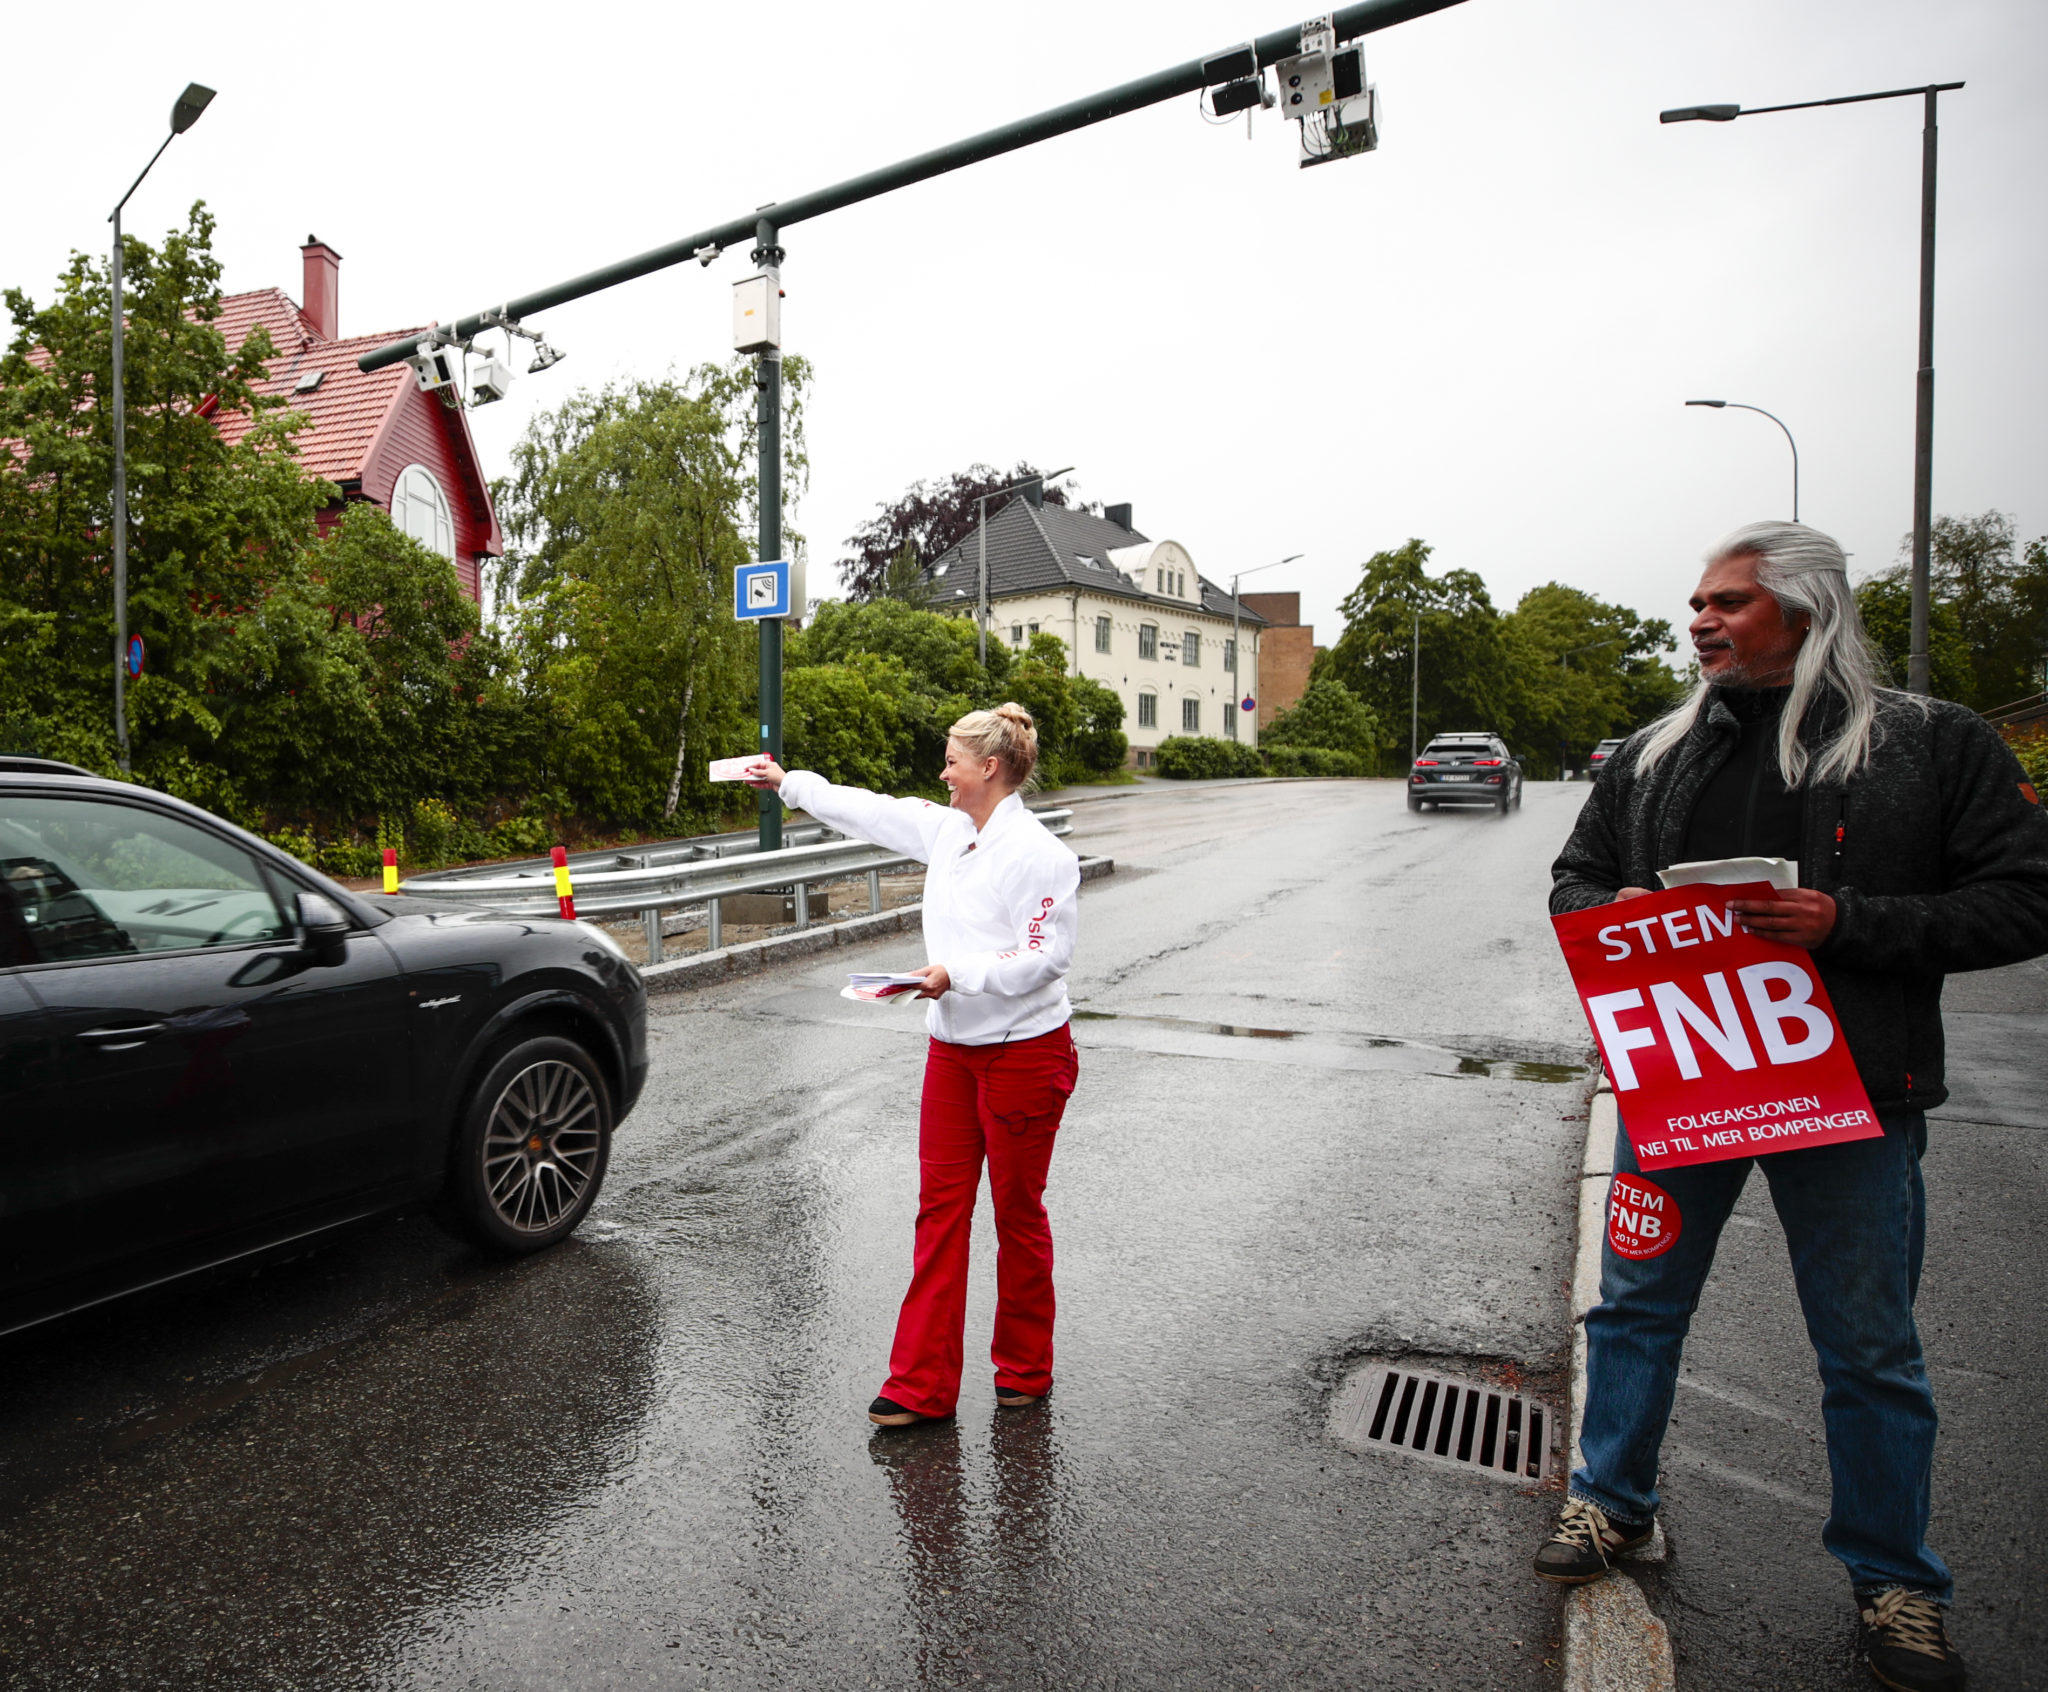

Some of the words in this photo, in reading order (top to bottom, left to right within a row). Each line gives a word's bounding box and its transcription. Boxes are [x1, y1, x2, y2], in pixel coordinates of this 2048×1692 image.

[1598, 904, 1749, 962] STEM
[1586, 960, 1835, 1092] FNB
[1666, 1095, 1821, 1132] FOLKEAKSJONEN
[1638, 1140, 1668, 1158] NEI
[1670, 1137, 1699, 1152] TIL
[1702, 1129, 1744, 1149] MER
[1747, 1109, 1871, 1142] BOMPENGER
[1613, 1180, 1664, 1212] STEM
[1610, 1200, 1661, 1238] FNB
[1615, 1231, 1639, 1247] 2019
